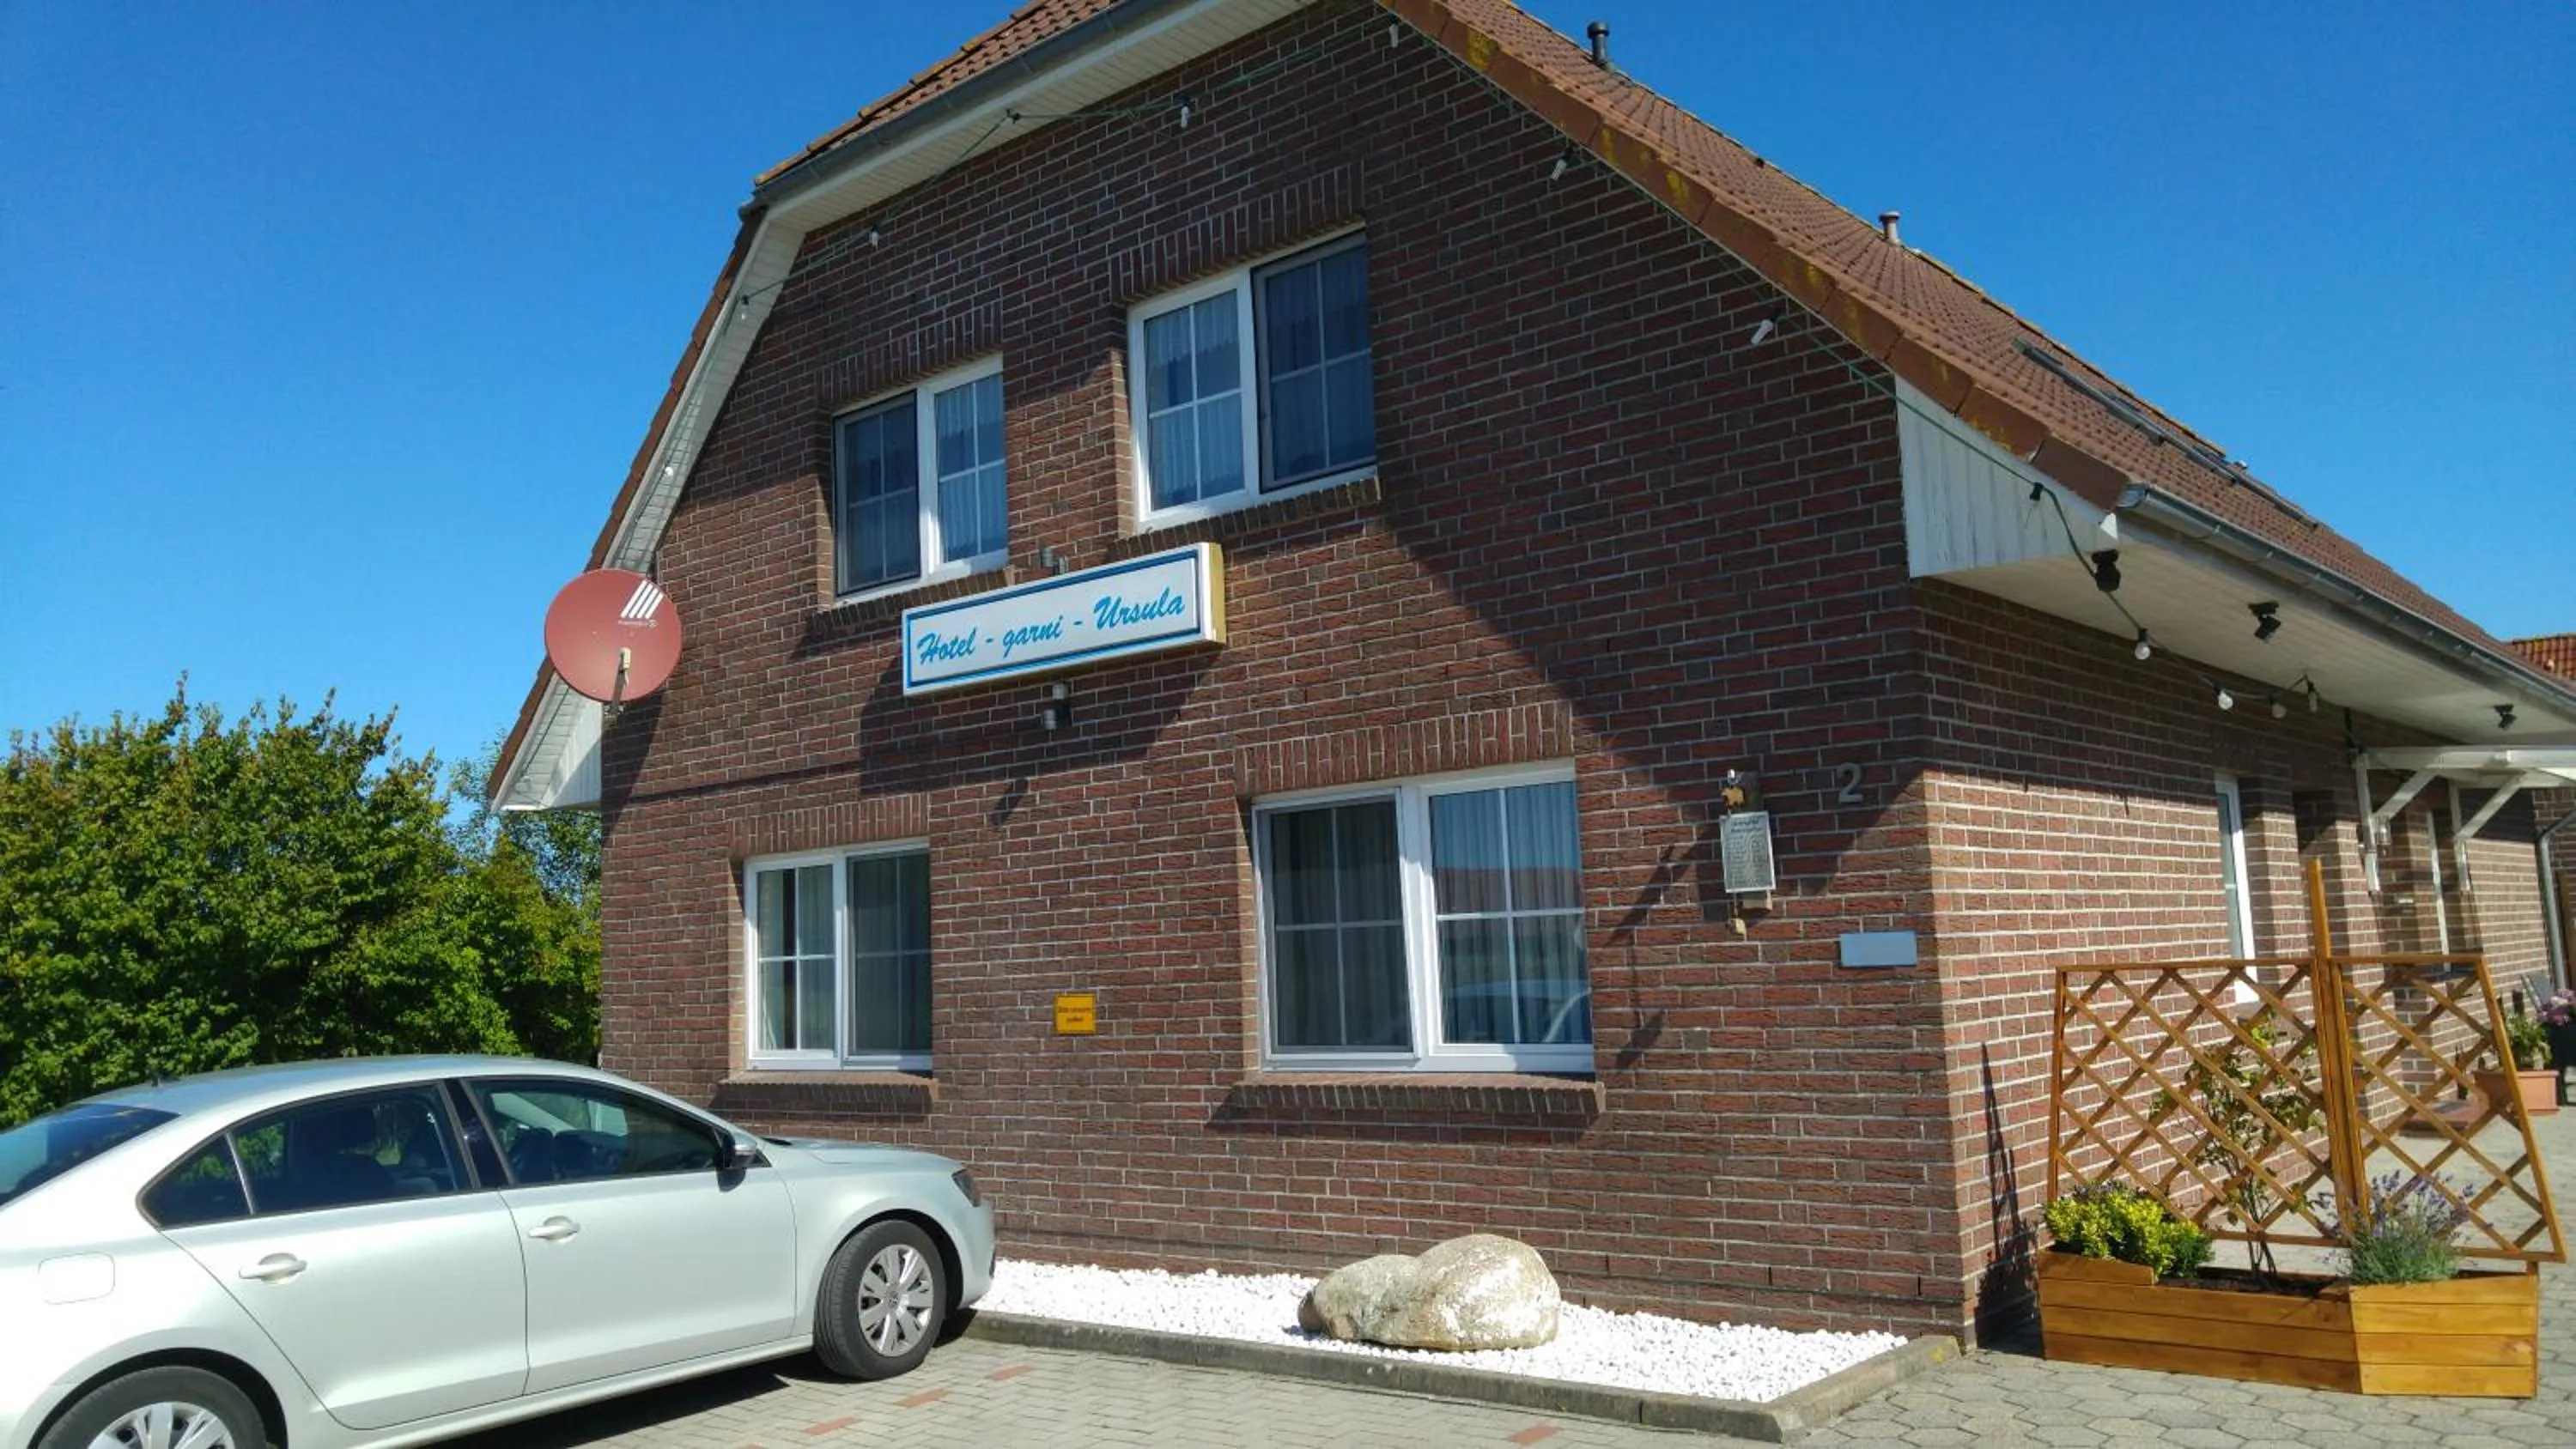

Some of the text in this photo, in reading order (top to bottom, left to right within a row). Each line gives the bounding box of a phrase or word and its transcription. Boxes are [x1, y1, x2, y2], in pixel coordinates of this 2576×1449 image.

[916, 627, 976, 664] Hotel
[1002, 615, 1063, 657] garni
[1093, 587, 1185, 630] Ursula
[1837, 762, 1862, 803] 2
